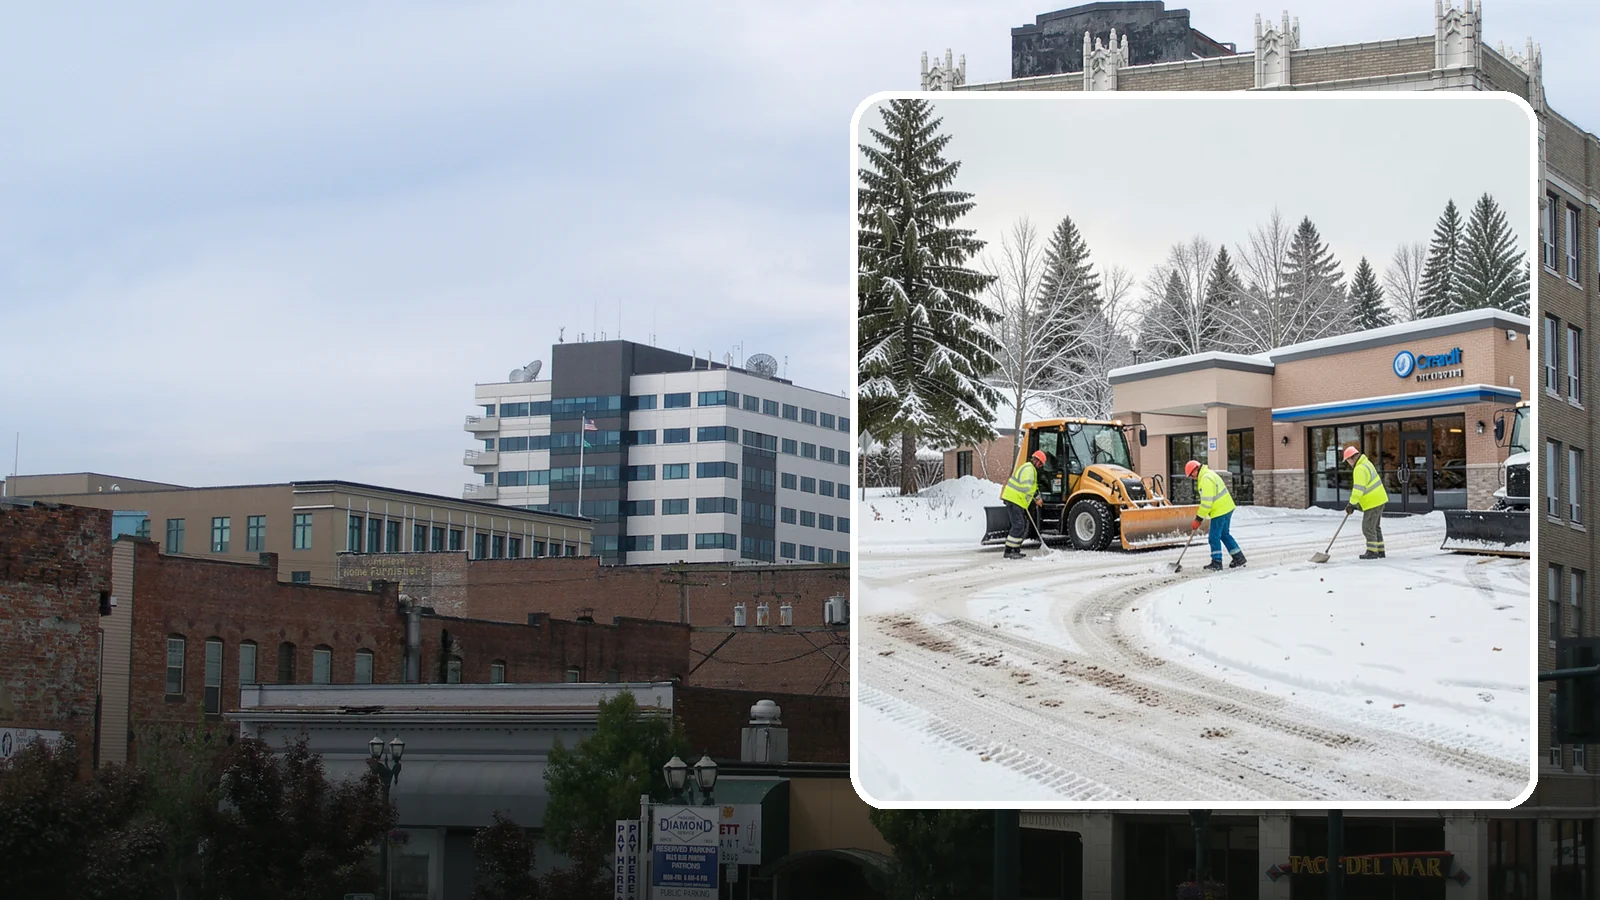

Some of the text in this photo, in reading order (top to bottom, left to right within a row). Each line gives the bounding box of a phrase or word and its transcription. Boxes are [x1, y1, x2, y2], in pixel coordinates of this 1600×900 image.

[371, 566, 427, 576] Furnishers
[660, 818, 713, 833] DIAMOND
[1022, 815, 1070, 828] BUILDING
[656, 845, 716, 854] RESERVED PARKING
[617, 825, 625, 893] PAY HERE
[628, 824, 637, 893] PAY HERE
[671, 862, 701, 870] PATRONS
[1289, 855, 1442, 877] TAC DEL MAR
[660, 888, 710, 898] PUBLIC PARKING
